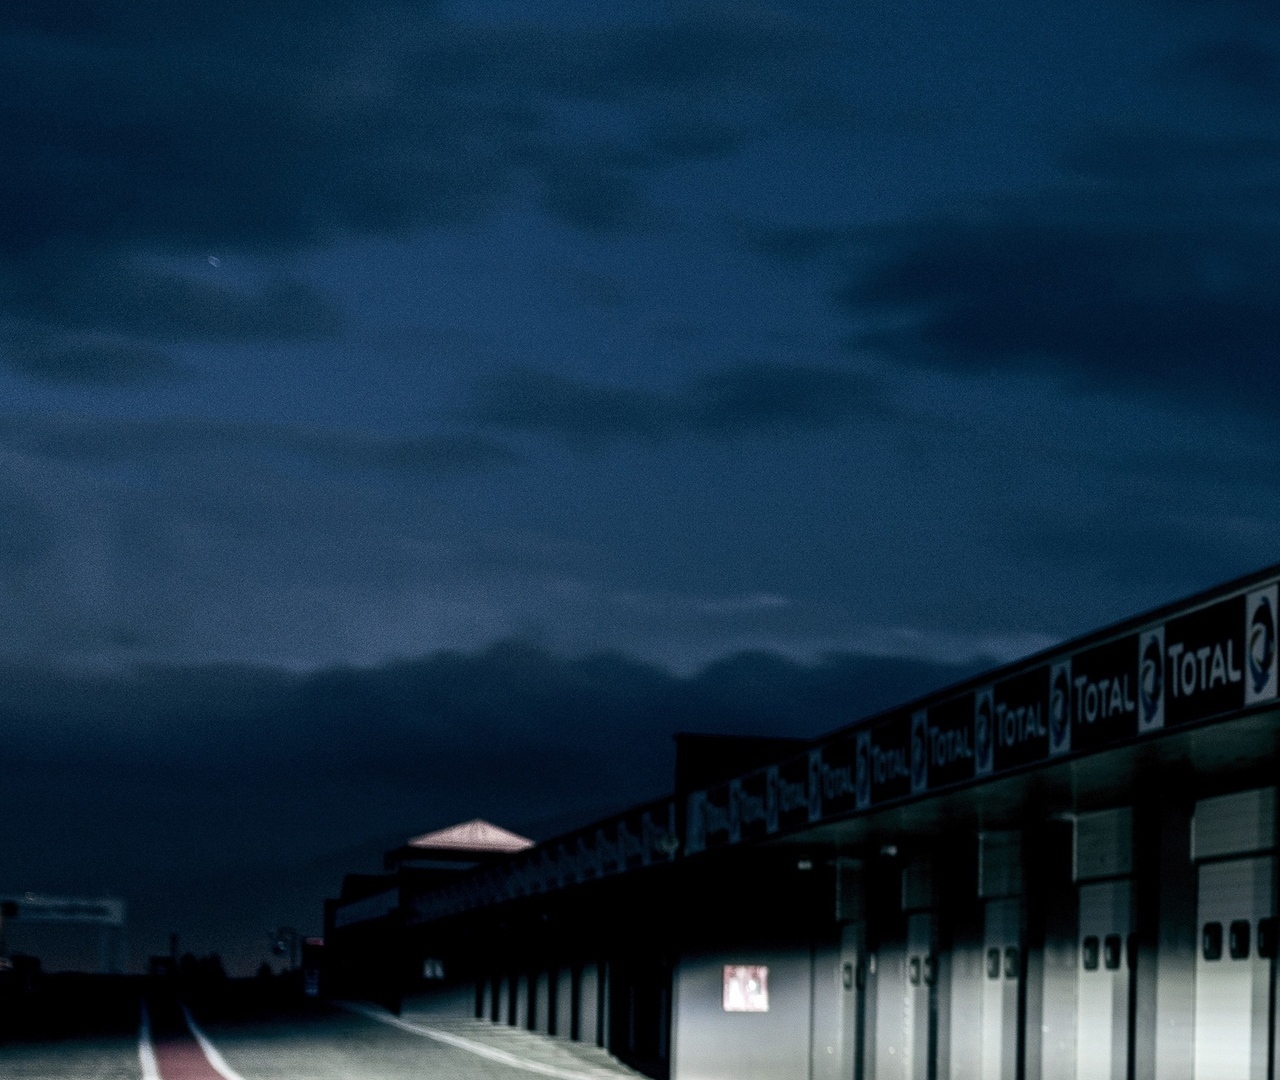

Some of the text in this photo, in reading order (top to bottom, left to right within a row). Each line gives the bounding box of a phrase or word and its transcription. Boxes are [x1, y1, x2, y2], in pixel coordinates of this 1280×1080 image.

[1167, 638, 1242, 697] TOTAL
[995, 700, 1047, 746] TOTAL
[1074, 673, 1135, 724] TOTAL
